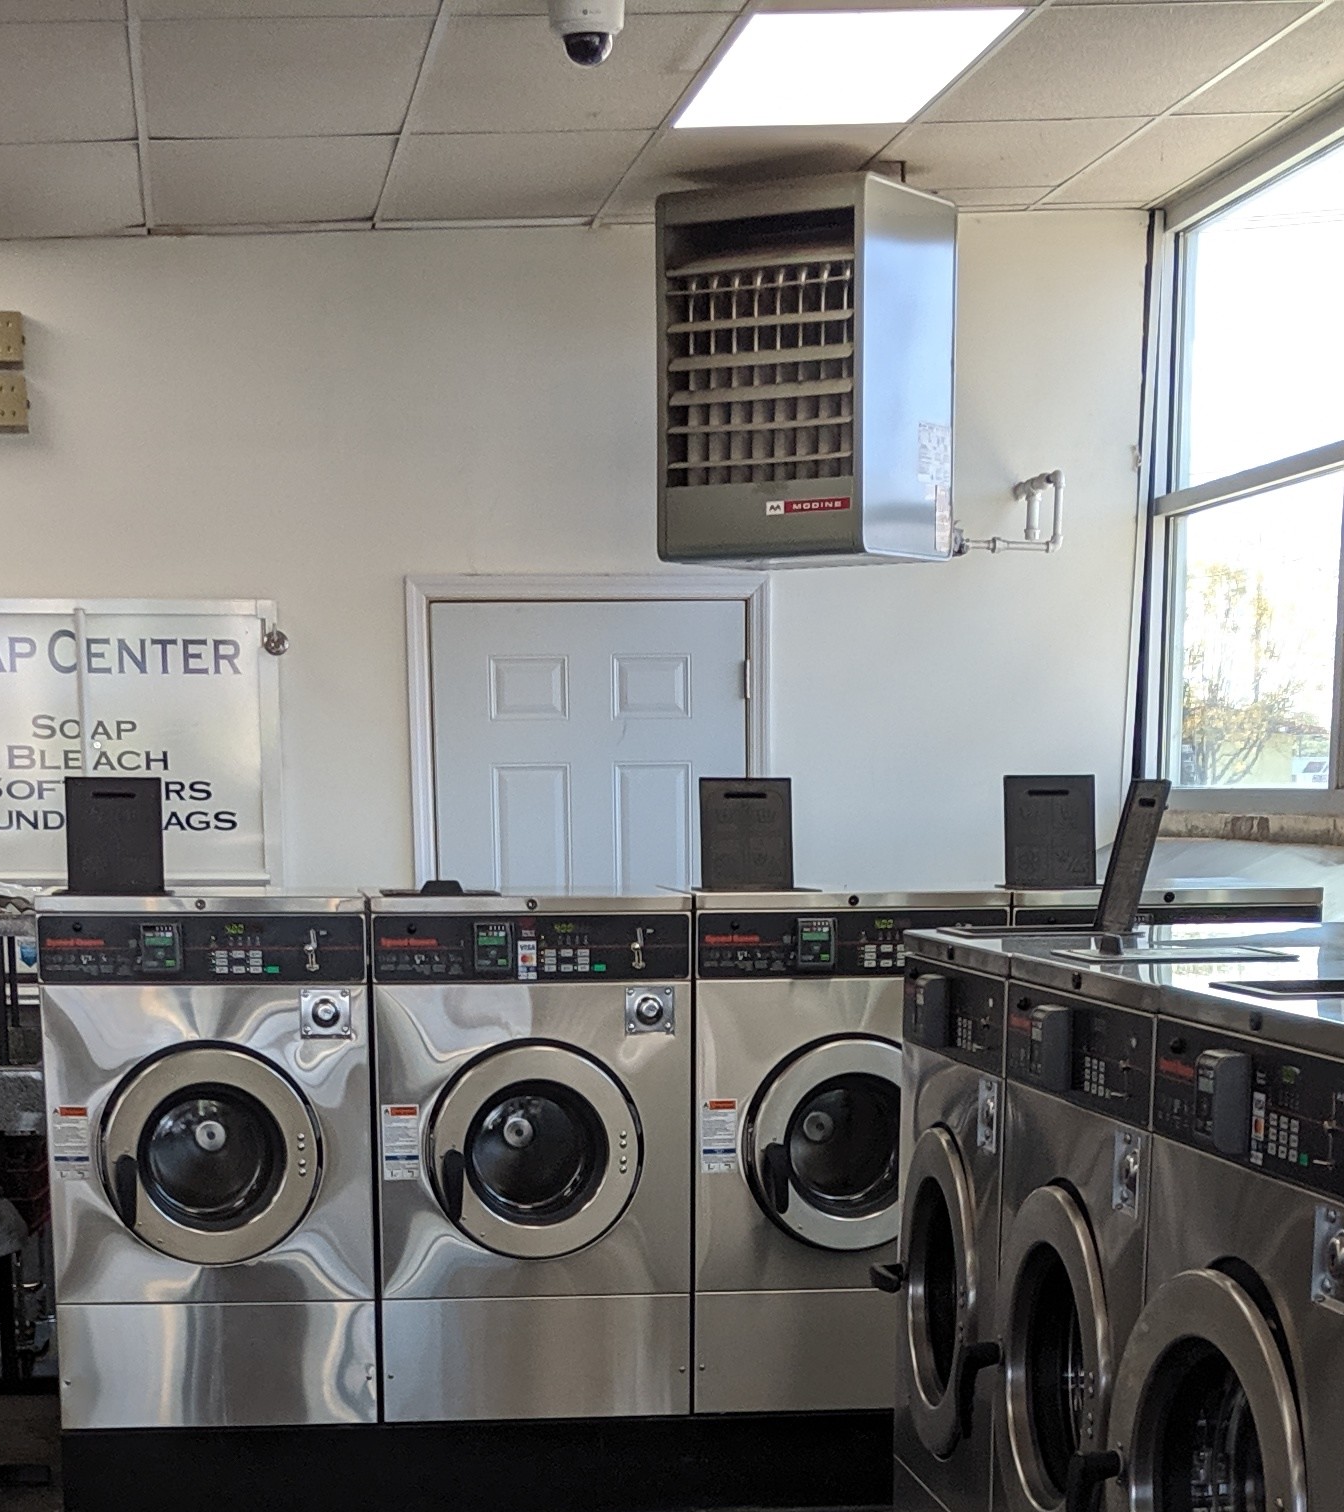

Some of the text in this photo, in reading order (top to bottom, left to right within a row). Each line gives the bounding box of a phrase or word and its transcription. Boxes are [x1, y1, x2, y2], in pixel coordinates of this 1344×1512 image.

[792, 501, 842, 510] MODINE
[31, 714, 137, 741] SOAP
[7, 744, 169, 771] BLEACH
[162, 810, 238, 831] AGS
